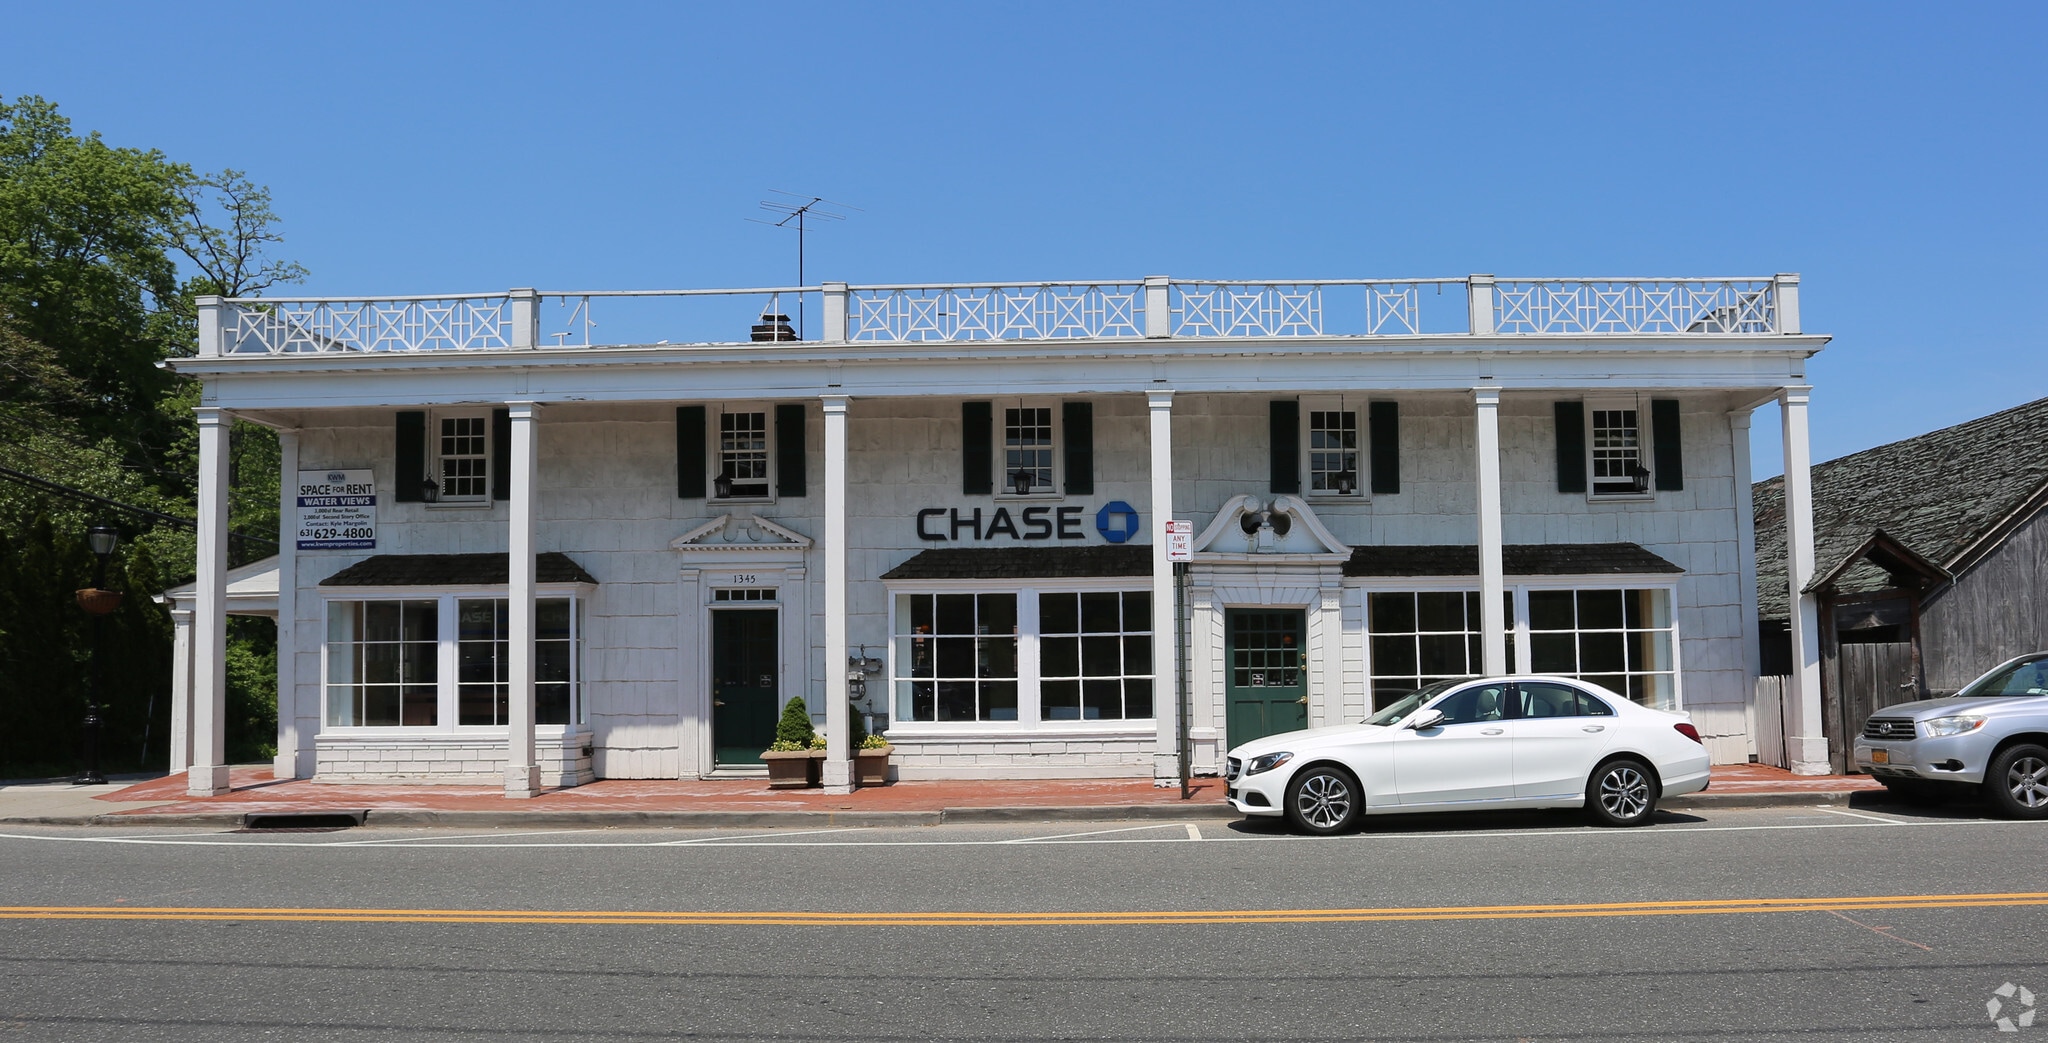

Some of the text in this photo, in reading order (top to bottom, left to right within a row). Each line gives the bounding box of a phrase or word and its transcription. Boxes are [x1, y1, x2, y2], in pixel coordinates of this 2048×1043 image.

[300, 484, 331, 495] SPACE
[346, 484, 372, 494] RENT
[304, 497, 370, 506] WATER VIEWS
[916, 506, 1086, 541] CHASE
[1166, 523, 1174, 532] NO
[299, 528, 373, 539] 631 629-4800
[734, 574, 756, 584] 1345
